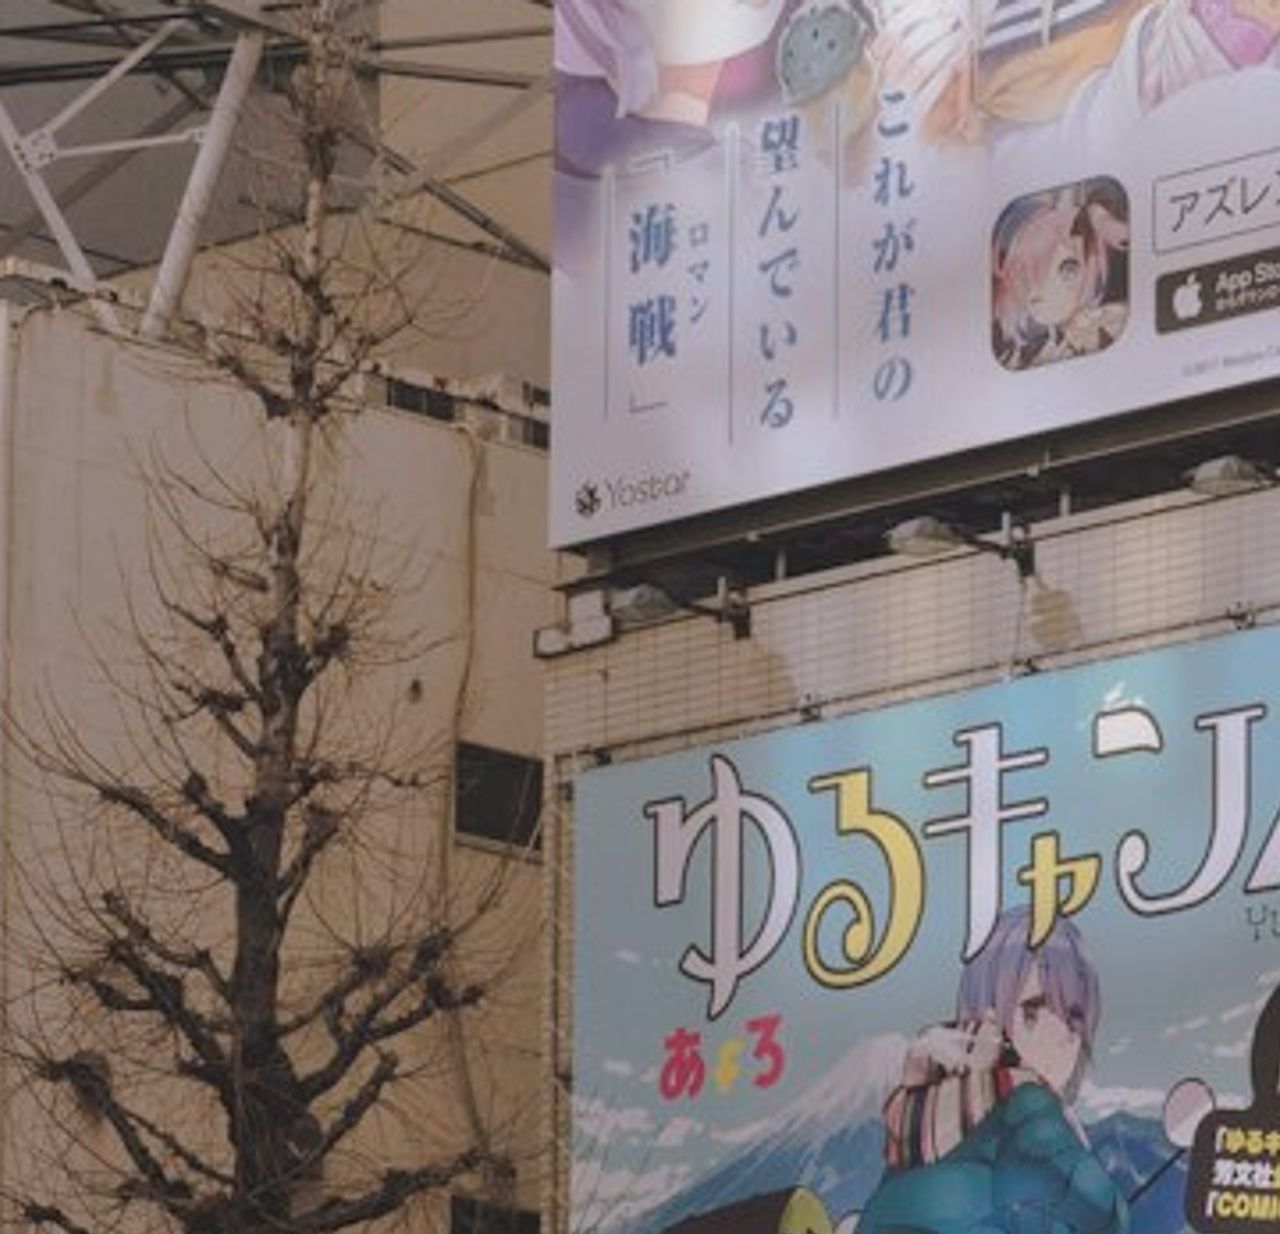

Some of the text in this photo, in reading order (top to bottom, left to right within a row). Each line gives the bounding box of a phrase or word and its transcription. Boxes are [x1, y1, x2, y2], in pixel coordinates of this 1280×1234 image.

[687, 223, 711, 325] ロマン
[759, 115, 801, 429] 望んでいる
[873, 91, 915, 402] これが君の
[1214, 268, 1252, 294] App
[603, 470, 691, 500] Yostar
